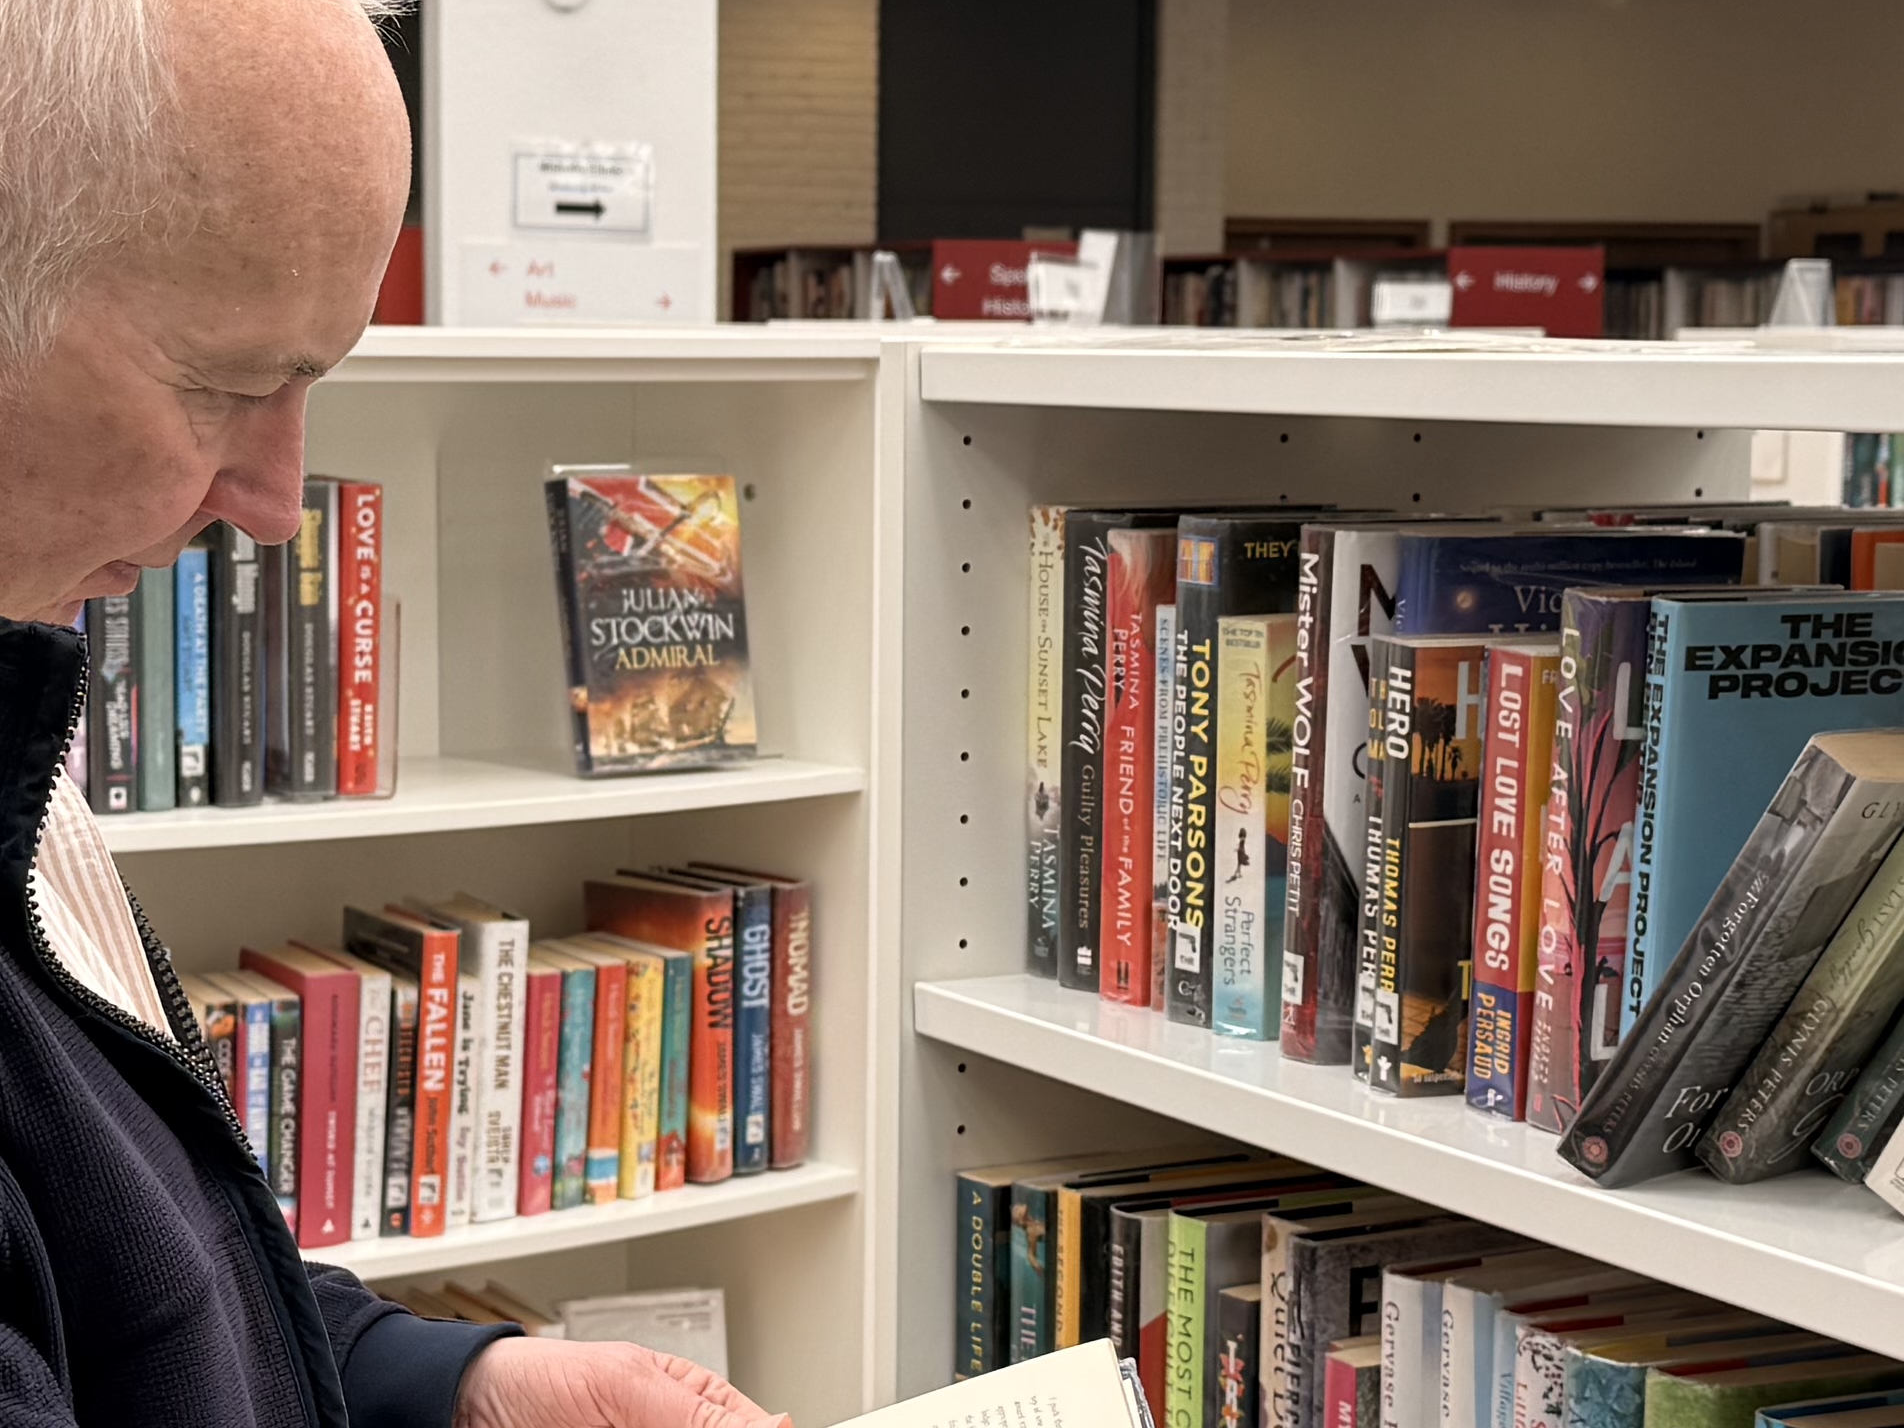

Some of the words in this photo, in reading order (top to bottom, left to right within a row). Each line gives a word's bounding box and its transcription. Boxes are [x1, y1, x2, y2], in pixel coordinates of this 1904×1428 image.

[356, 494, 375, 560] LOVE
[355, 600, 374, 684] CURSE
[590, 613, 736, 647] STOCKWIN
[621, 586, 697, 614] JULIAN
[1296, 550, 1319, 667] Mister
[1780, 613, 1876, 638] THE
[614, 644, 721, 670] ADMIRAL
[1175, 629, 1188, 678] THE
[1191, 638, 1211, 744] TONY
[1556, 626, 1579, 743] LOVE
[1172, 684, 1186, 780] PEOPLE
[1290, 679, 1313, 788] WOLF
[1386, 665, 1412, 760] HERO
[1497, 661, 1523, 746] LOST
[1170, 785, 1184, 852] NEXT
[1491, 754, 1519, 840] LOVE
[1546, 762, 1570, 879] AFTER
[1185, 754, 1208, 929] PARSONS
[1168, 856, 1182, 931] DOOR
[1484, 847, 1514, 971] SONGS
[498, 939, 515, 968] THE
[704, 915, 733, 1030] SHADOW
[742, 924, 770, 1008] GHOST
[1537, 896, 1559, 1011] LOVE
[422, 988, 449, 1091] FALLEN
[494, 973, 513, 1050] CHESTNUT
[1472, 991, 1495, 1081] PERSAUD
[1494, 993, 1511, 1074] INGRID
[493, 1055, 510, 1089] MAN
